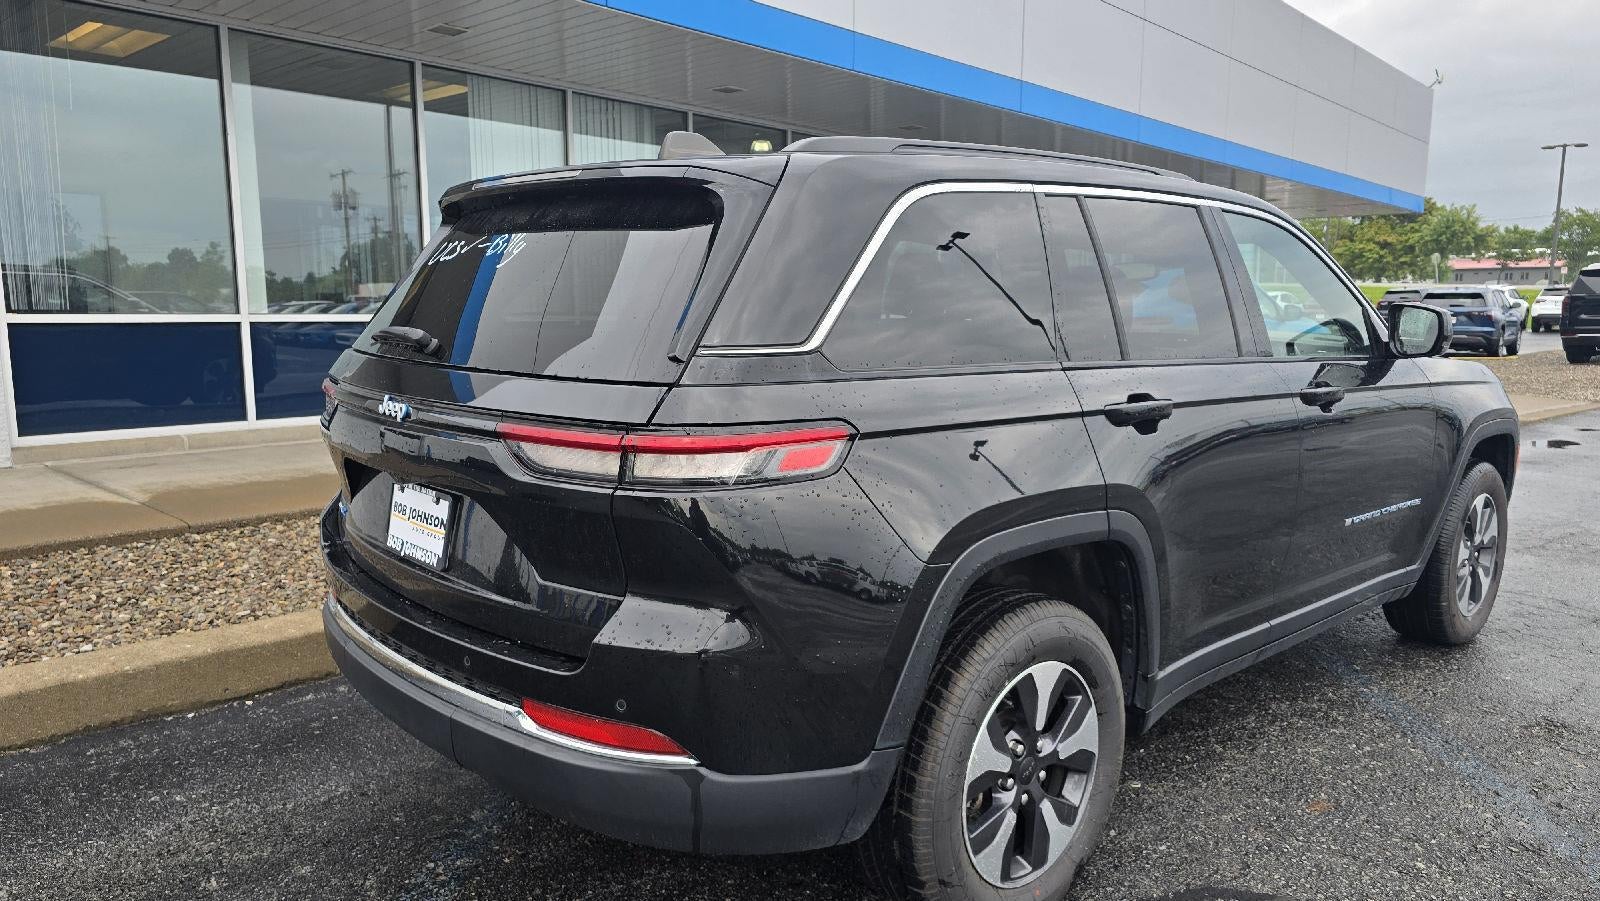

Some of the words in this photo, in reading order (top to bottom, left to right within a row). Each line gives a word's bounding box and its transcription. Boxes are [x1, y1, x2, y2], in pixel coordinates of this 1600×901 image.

[379, 394, 409, 422] Jeep
[393, 501, 407, 516] BOB
[408, 506, 447, 530] JOHNSON
[1353, 510, 1381, 523] GRAND
[1381, 498, 1421, 514] CHEROKEE
[387, 533, 403, 552] BOB
[401, 540, 440, 567] JOHNSON
